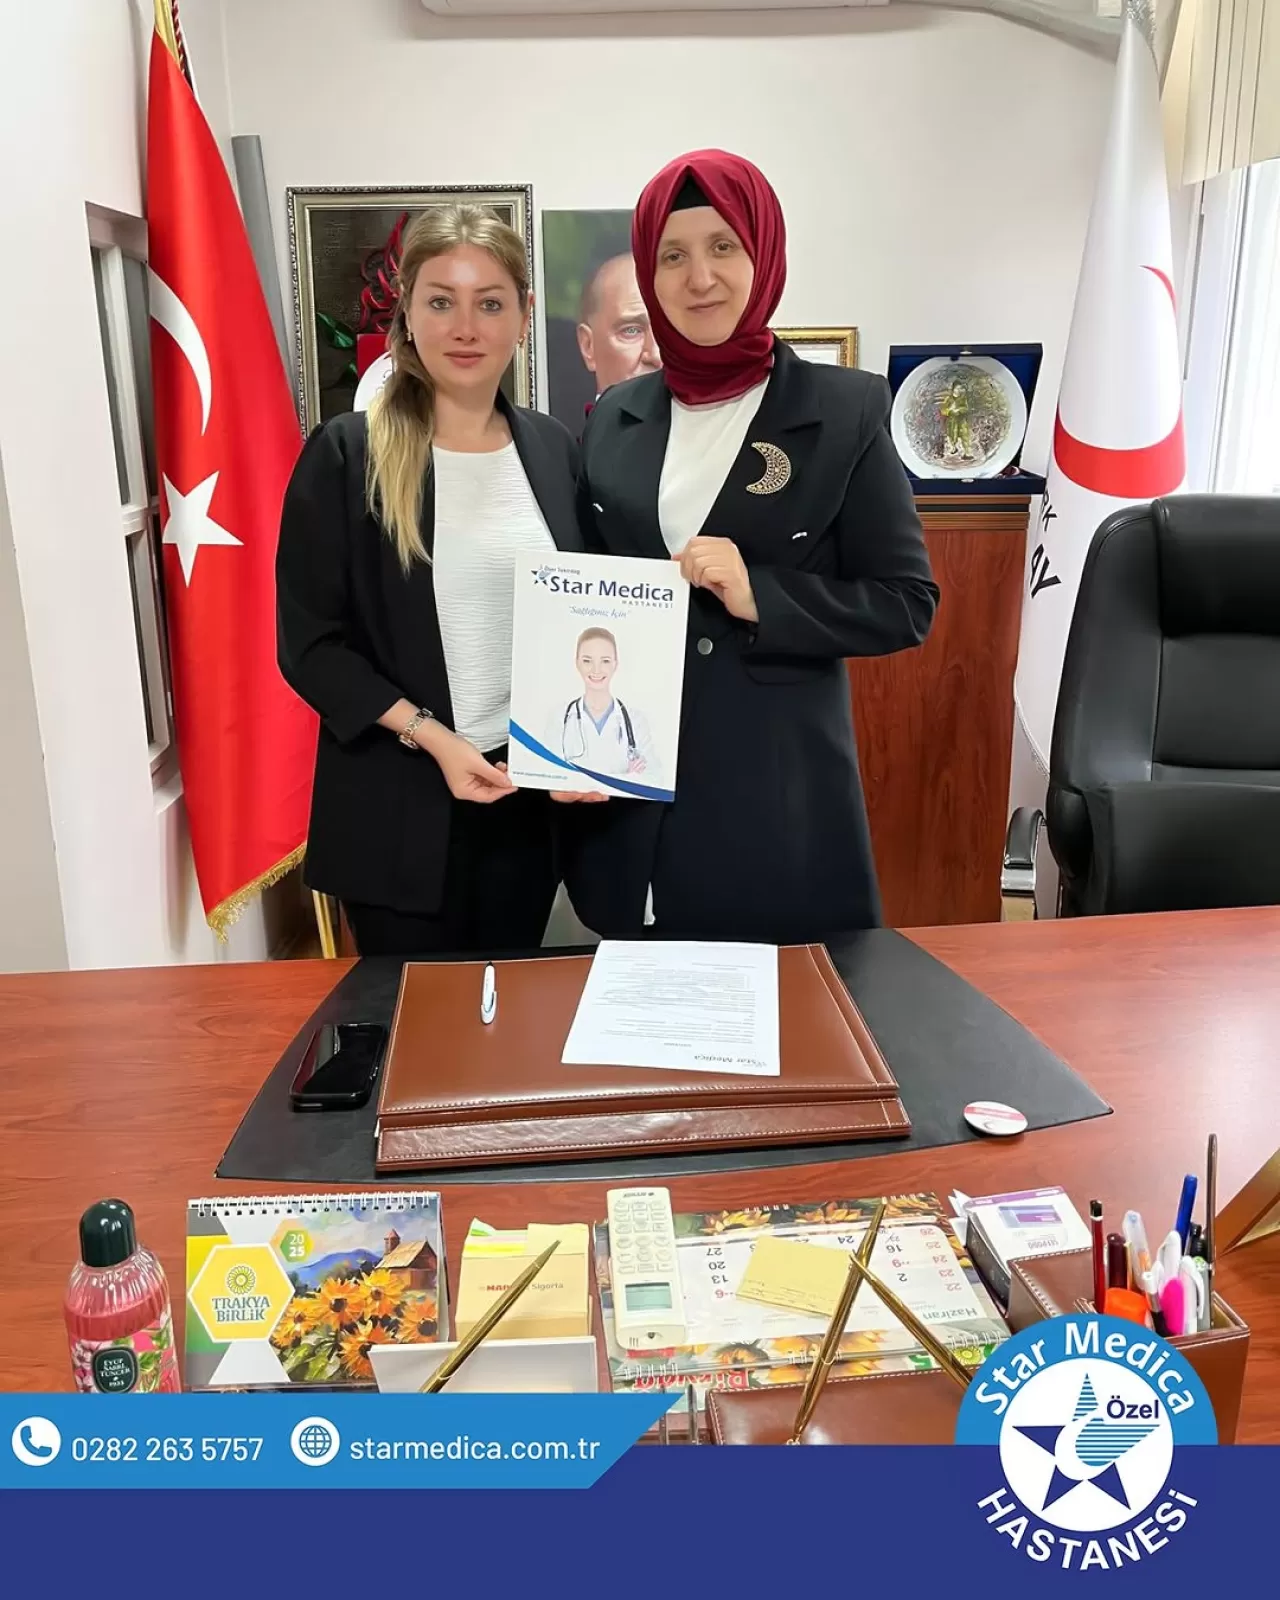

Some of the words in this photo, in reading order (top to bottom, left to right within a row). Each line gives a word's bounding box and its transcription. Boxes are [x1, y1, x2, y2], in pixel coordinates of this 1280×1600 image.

[550, 575, 593, 595] Star
[598, 580, 674, 601] Medica
[288, 1233, 305, 1245] 20
[837, 1235, 855, 1244] 24
[288, 1246, 305, 1257] 25
[706, 1247, 723, 1256] 27
[886, 1244, 903, 1253] 16
[708, 1261, 726, 1270] 20
[711, 1274, 729, 1284] 13
[897, 1272, 908, 1282] 2
[531, 1283, 564, 1293] Sigorta
[211, 1295, 271, 1311] TRAKYA
[922, 1307, 977, 1321] Haziran
